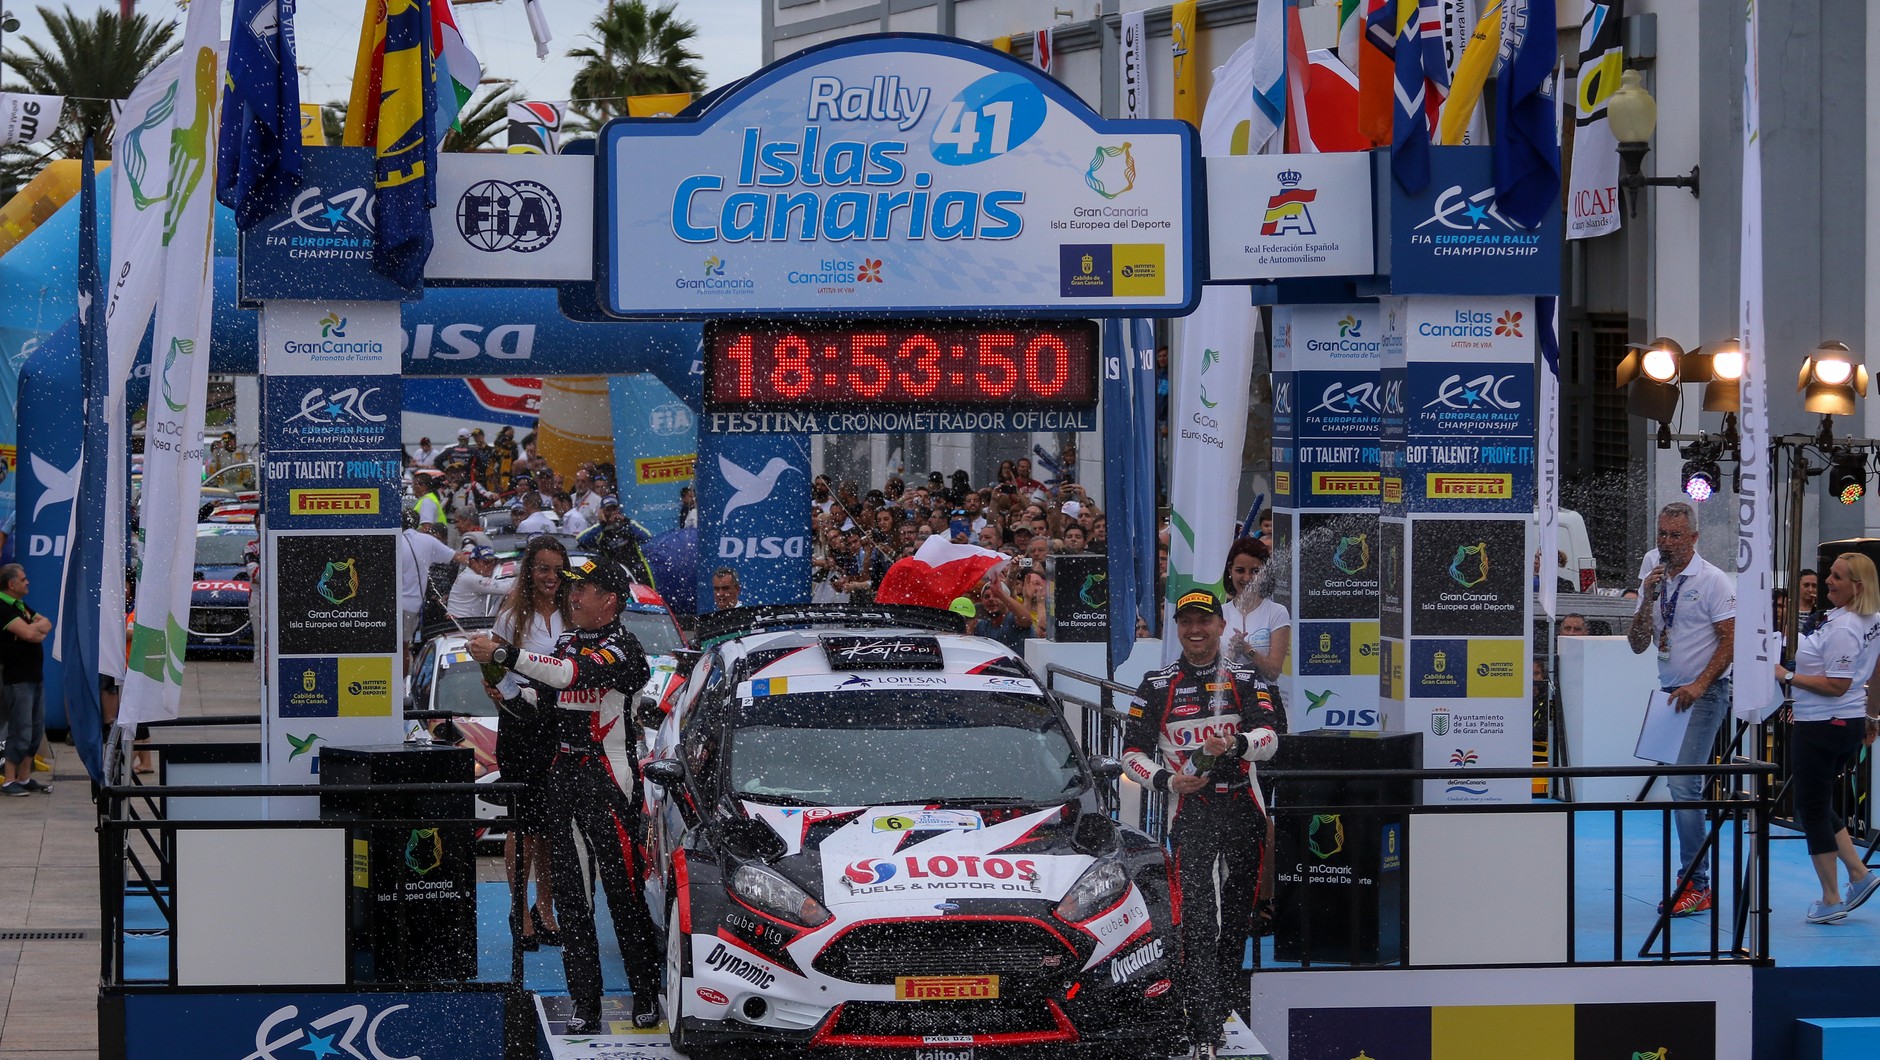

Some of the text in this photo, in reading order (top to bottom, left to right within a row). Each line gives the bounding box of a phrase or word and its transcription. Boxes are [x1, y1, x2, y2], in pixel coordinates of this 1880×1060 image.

[808, 76, 931, 131] Rally
[932, 101, 1013, 154] 41
[736, 125, 907, 187] Islas
[670, 171, 1026, 245] Canarias
[1073, 206, 1149, 217] Gran Canaria
[1050, 220, 1171, 231] Isla Europea del Deporte
[266, 236, 287, 246] FIA
[291, 237, 359, 248] EUROPEAN
[1411, 235, 1540, 244] FIA EUROPEAN RALLY
[1244, 241, 1339, 254] Real Federación Española
[1433, 246, 1538, 256] CHAMPIONSHIP
[820, 259, 855, 271] Islas
[1258, 254, 1326, 264] de Automovilismo
[788, 270, 855, 284] Canarias
[1455, 309, 1493, 324] Islas
[1419, 322, 1493, 337] Canarias
[1329, 352, 1360, 360] Patronato
[727, 333, 1069, 398] 18:53:50
[1423, 374, 1521, 410] ERC
[284, 387, 387, 424] ERC
[711, 409, 1088, 433] FESTINA CRONOMETRADOR OFICIAL
[1439, 412, 1490, 420] EUROPEAN
[302, 426, 353, 434] EUROPEAN
[356, 426, 386, 434] RALLY
[1437, 421, 1518, 429] CHAMPIONSHIP
[300, 435, 385, 444] CHAMPIONSHIP
[1300, 447, 1360, 463] OT TALENT?
[1406, 446, 1534, 464] GOT TALENT? PROVE IT!
[268, 460, 383, 479] GOT TALENT? PROVE
[1435, 477, 1504, 494] PIRELLI
[298, 493, 371, 510] PIRELLI
[718, 536, 804, 558] DISA
[1324, 579, 1378, 588] Gran Canaria
[1308, 589, 1321, 597] Isla
[1322, 589, 1351, 599] Europea
[1352, 588, 1364, 597] del
[1440, 592, 1498, 601] Gran Canaria
[1422, 602, 1515, 612] Isla Europea del Deporte
[308, 609, 369, 619] Gran Canaria
[1073, 612, 1091, 620] Gran
[289, 620, 387, 630] Isla Europea del Deporte
[1070, 620, 1097, 628] Europea
[537, 655, 563, 668] LOTOS
[877, 676, 947, 684] LOPESAN
[560, 688, 597, 704] LOTOS
[1325, 709, 1380, 727] DIS
[1453, 714, 1504, 723] Ayuntamiento
[886, 817, 903, 830] 6
[905, 855, 1036, 881] LOTOS
[417, 880, 453, 889] Canaria
[1278, 873, 1338, 884] Isla del
[850, 881, 1042, 896] FUELS & MOTOR OILS
[377, 891, 438, 902] Isla del
[726, 912, 783, 945] cube itg
[1100, 914, 1124, 937] cube
[705, 942, 776, 990] Dynamic
[1110, 938, 1164, 984] Dynamic
[905, 977, 990, 998] PIRELLI
[1146, 982, 1170, 995] DELPHI
[699, 989, 727, 1003] DELPHI
